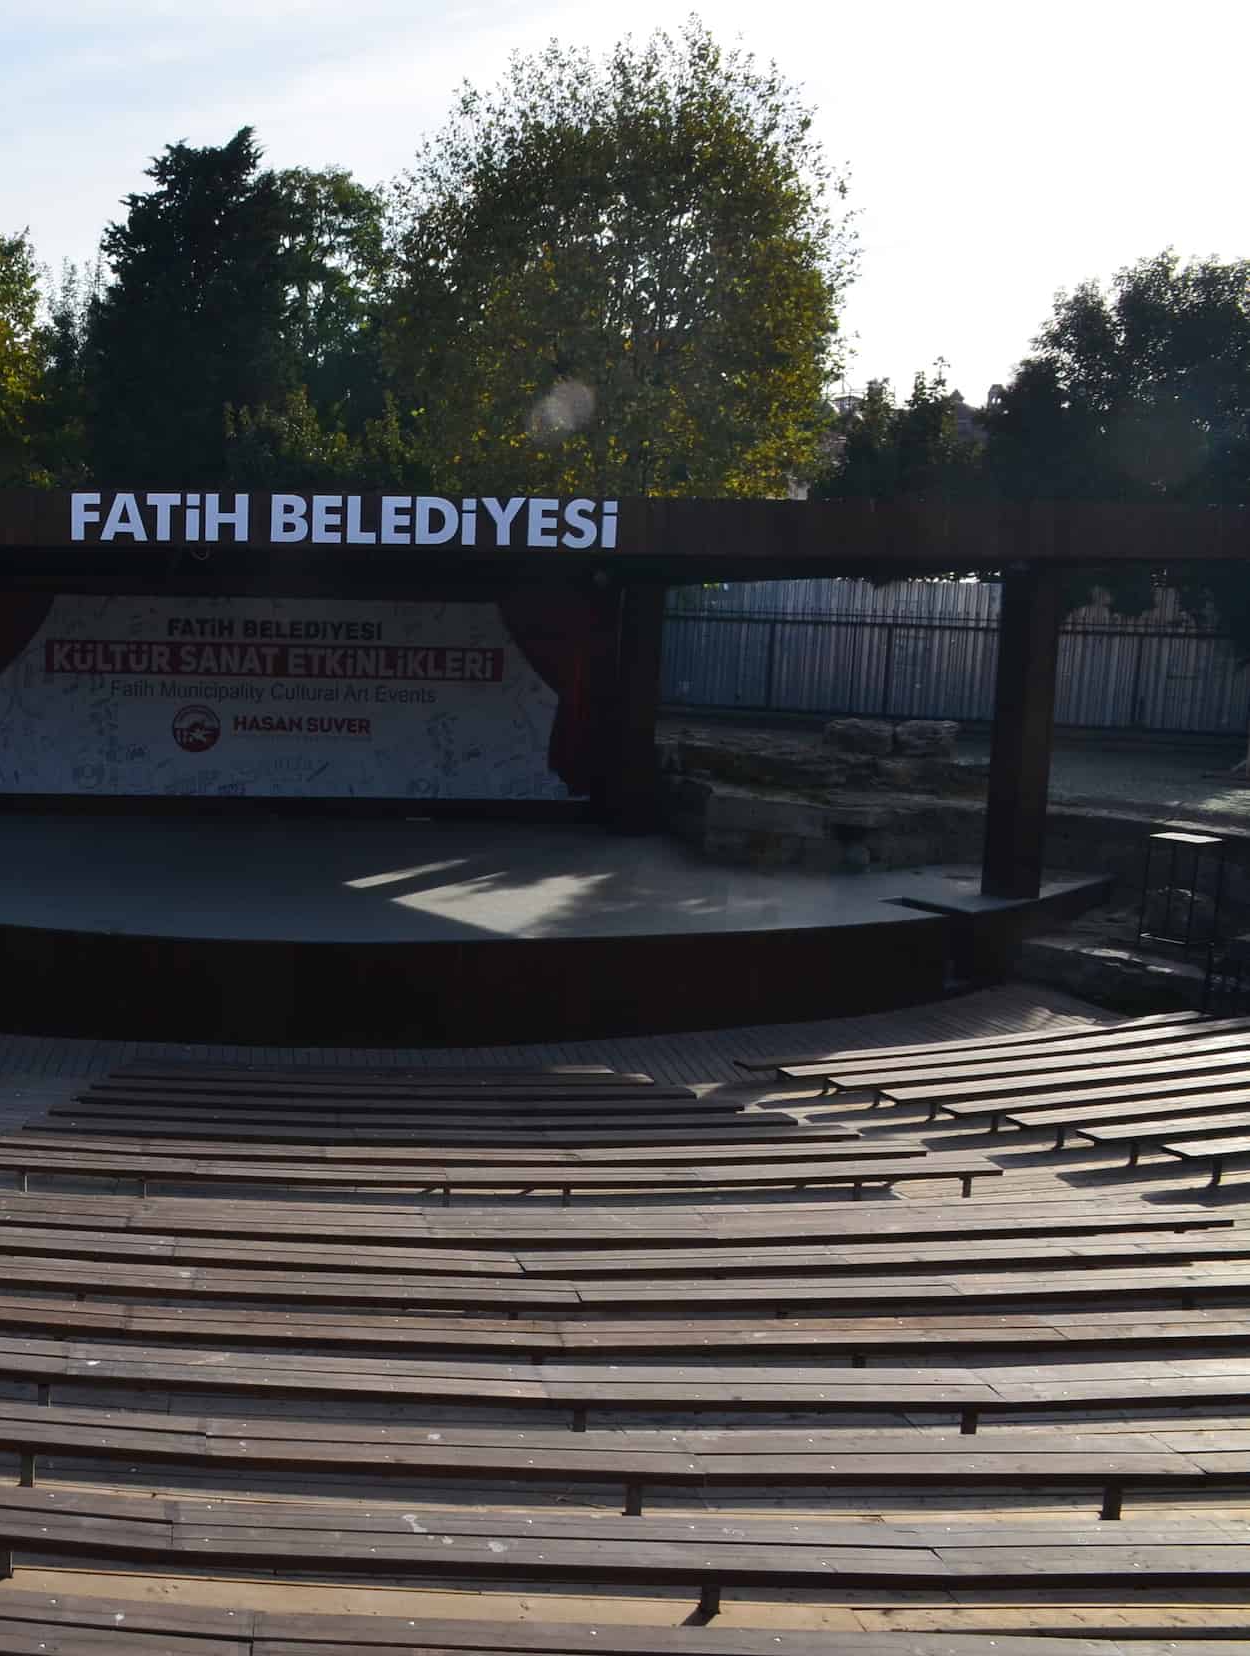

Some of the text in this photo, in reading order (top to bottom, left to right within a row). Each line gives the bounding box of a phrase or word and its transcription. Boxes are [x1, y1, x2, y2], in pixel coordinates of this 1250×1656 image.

[53, 641, 172, 673] KÜLTÜR
[179, 644, 279, 675] SANAT
[110, 679, 438, 704] Fatih Municipality Cultural Art Events
[234, 714, 371, 735] HASAN SUVER
